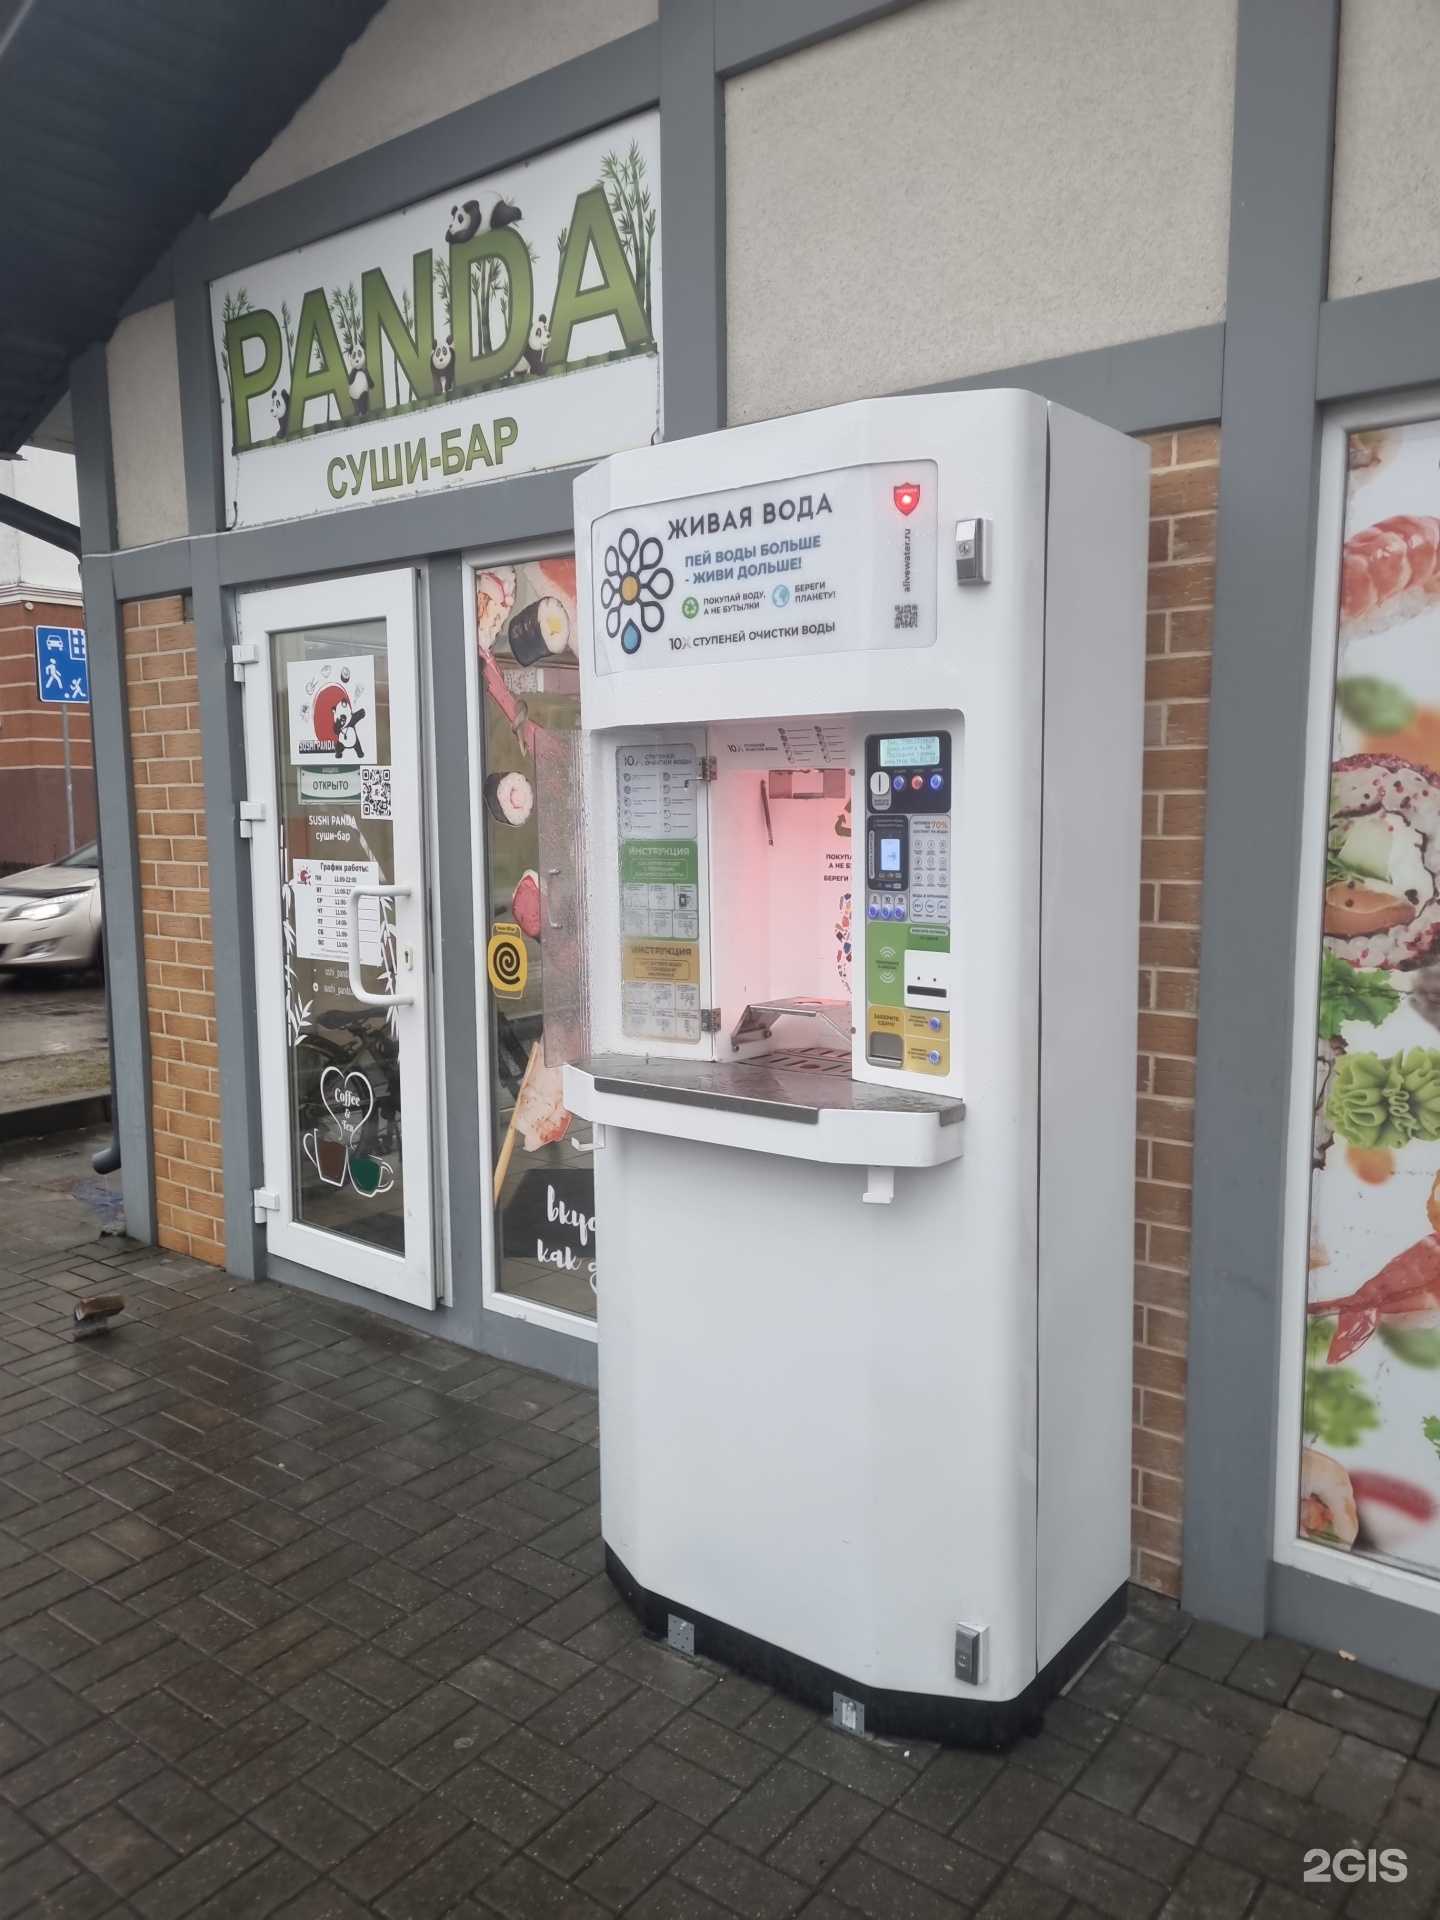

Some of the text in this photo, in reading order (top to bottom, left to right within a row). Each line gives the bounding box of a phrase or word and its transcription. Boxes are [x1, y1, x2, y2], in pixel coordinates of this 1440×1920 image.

[225, 184, 652, 454] PANDA
[327, 416, 519, 499] СУШИ-БАР
[668, 493, 833, 540] ЖИВАЯ ВОДА
[685, 535, 821, 567] ПЕЙ ВОДЫ БОЛЬШЕ
[903, 528, 912, 593] alivewater.ru
[693, 566, 734, 585] ЖИВИ
[737, 557, 802, 581] ДОЛЬШЕ!
[794, 581, 826, 593] БЕРЕГИ
[703, 592, 741, 605] ПОКУПАЙ
[795, 591, 836, 603] ПЛАНЕТУ!
[711, 607, 721, 615] НЕ
[723, 602, 760, 614] БУТЫЛКИ
[692, 632, 746, 648] СТУПЕНЕЙ
[749, 626, 799, 641] ОЧИСТКИ
[801, 621, 836, 636] ВОДЫ
[313, 780, 349, 790] ОТКРЫТО
[309, 815, 356, 827] SUSHI PANDA
[315, 832, 351, 842] суши-бар
[629, 847, 690, 857] ИНСТРУКЦИЯ
[320, 862, 342, 873] График
[334, 1087, 361, 1107] Coffee
[341, 1119, 354, 1132] Tea
